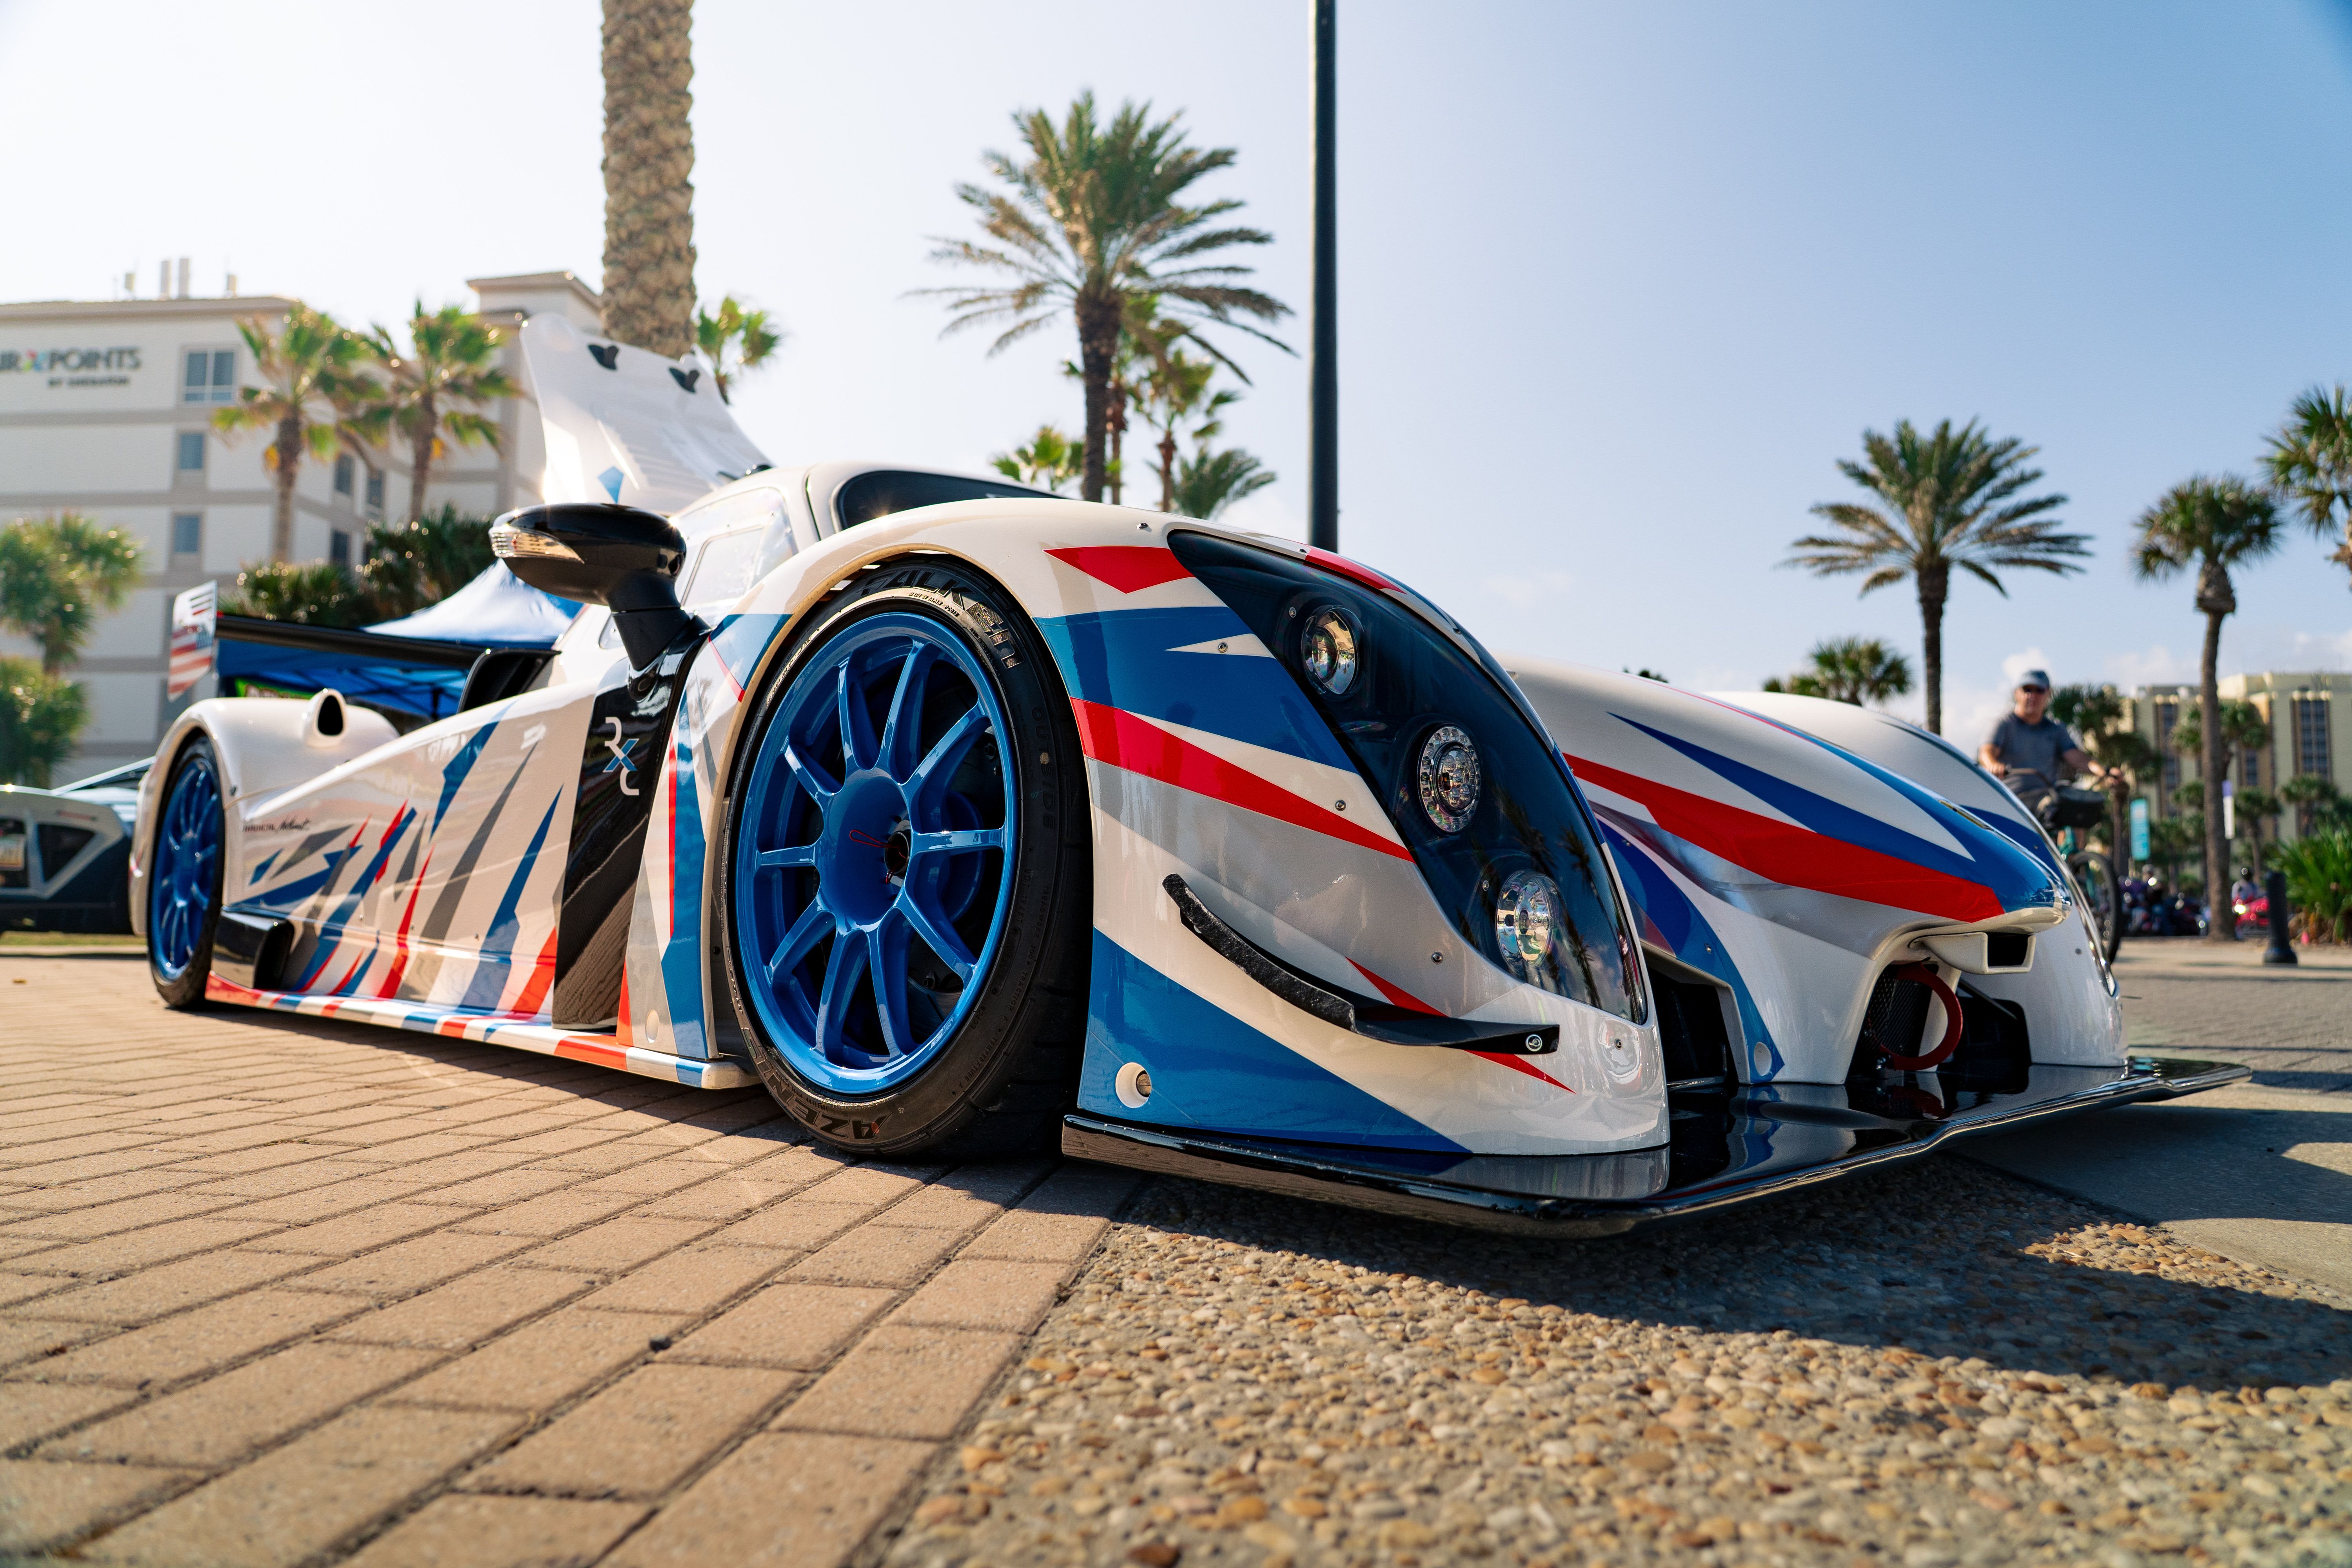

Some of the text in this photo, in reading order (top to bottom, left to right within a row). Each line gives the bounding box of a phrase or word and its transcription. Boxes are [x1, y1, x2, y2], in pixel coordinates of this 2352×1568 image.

[49, 347, 140, 370] POINTS
[928, 597, 944, 606] JAPAN
[1031, 791, 1039, 799] 97
